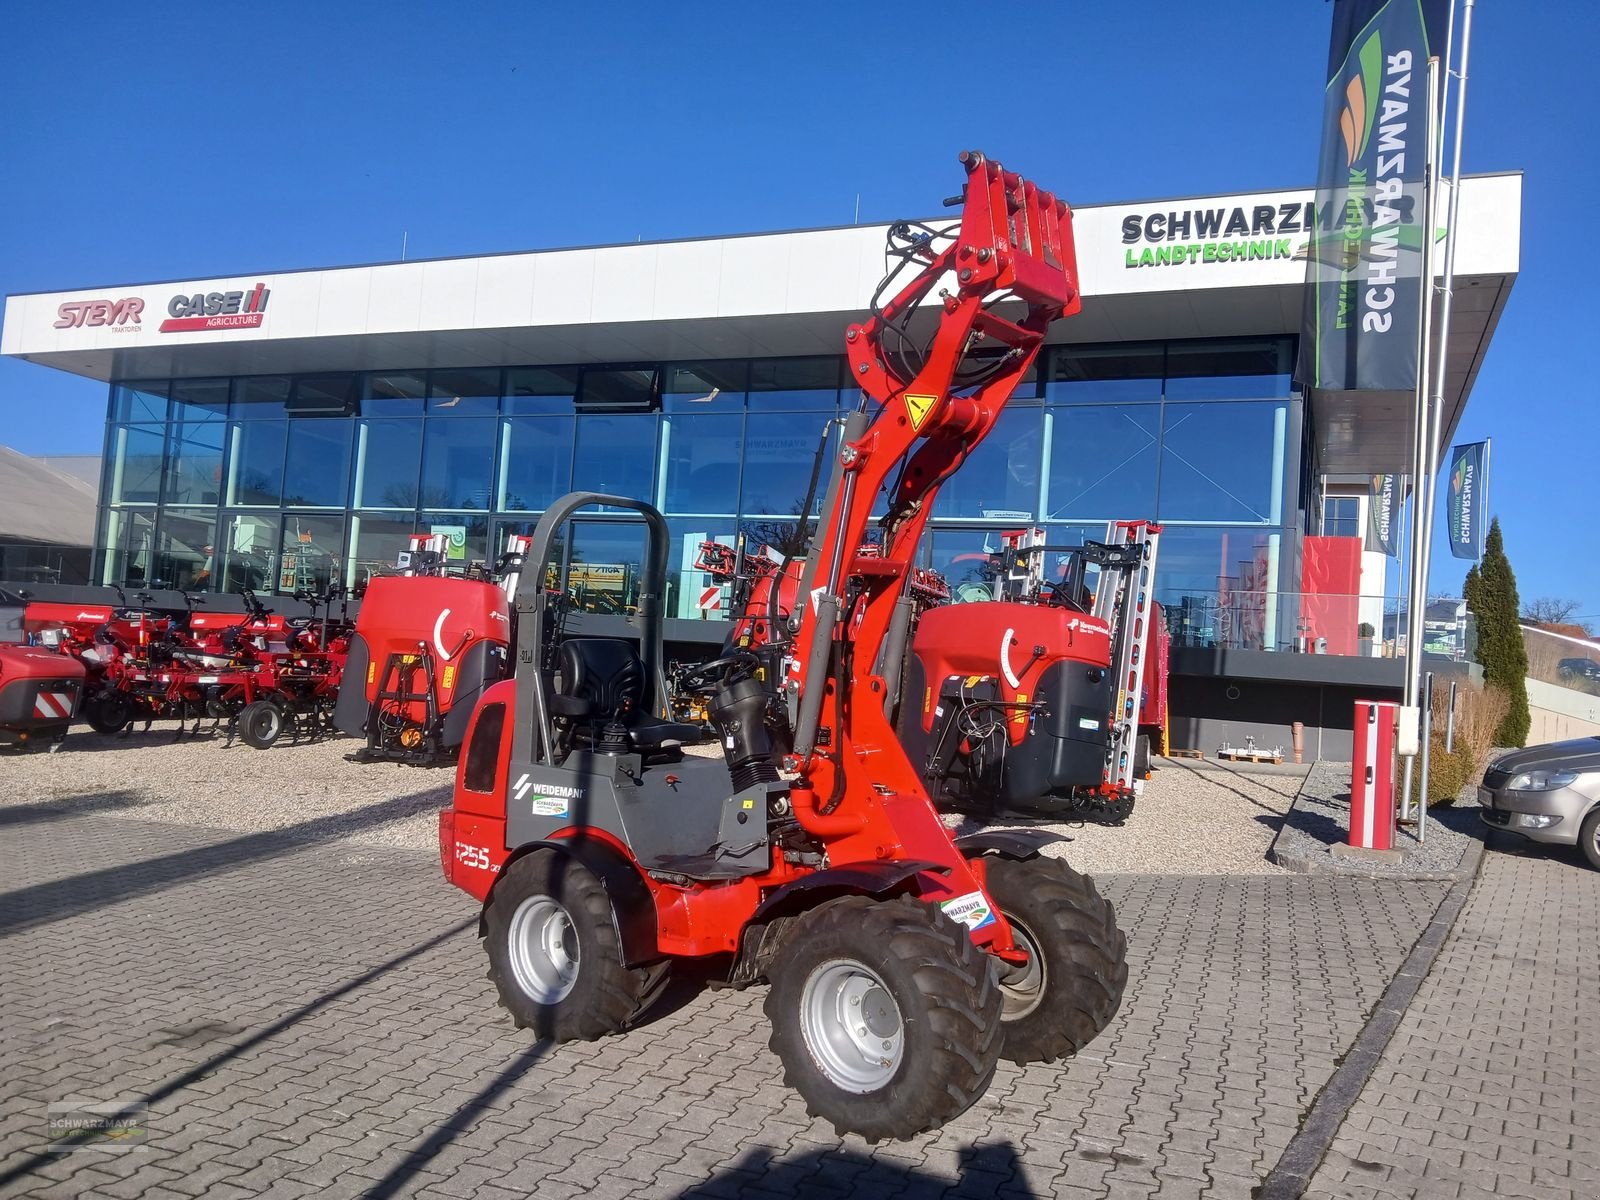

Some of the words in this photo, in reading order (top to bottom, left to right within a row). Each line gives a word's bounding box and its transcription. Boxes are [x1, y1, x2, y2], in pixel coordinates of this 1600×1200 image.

[1125, 238, 1292, 268] LANDTECHNIK
[53, 296, 146, 329] STEYR
[168, 291, 244, 318] CASE
[111, 325, 142, 334] TRAKTOREN
[205, 315, 258, 328] AGRICULTURE
[735, 439, 807, 449] SHWARZMAYR
